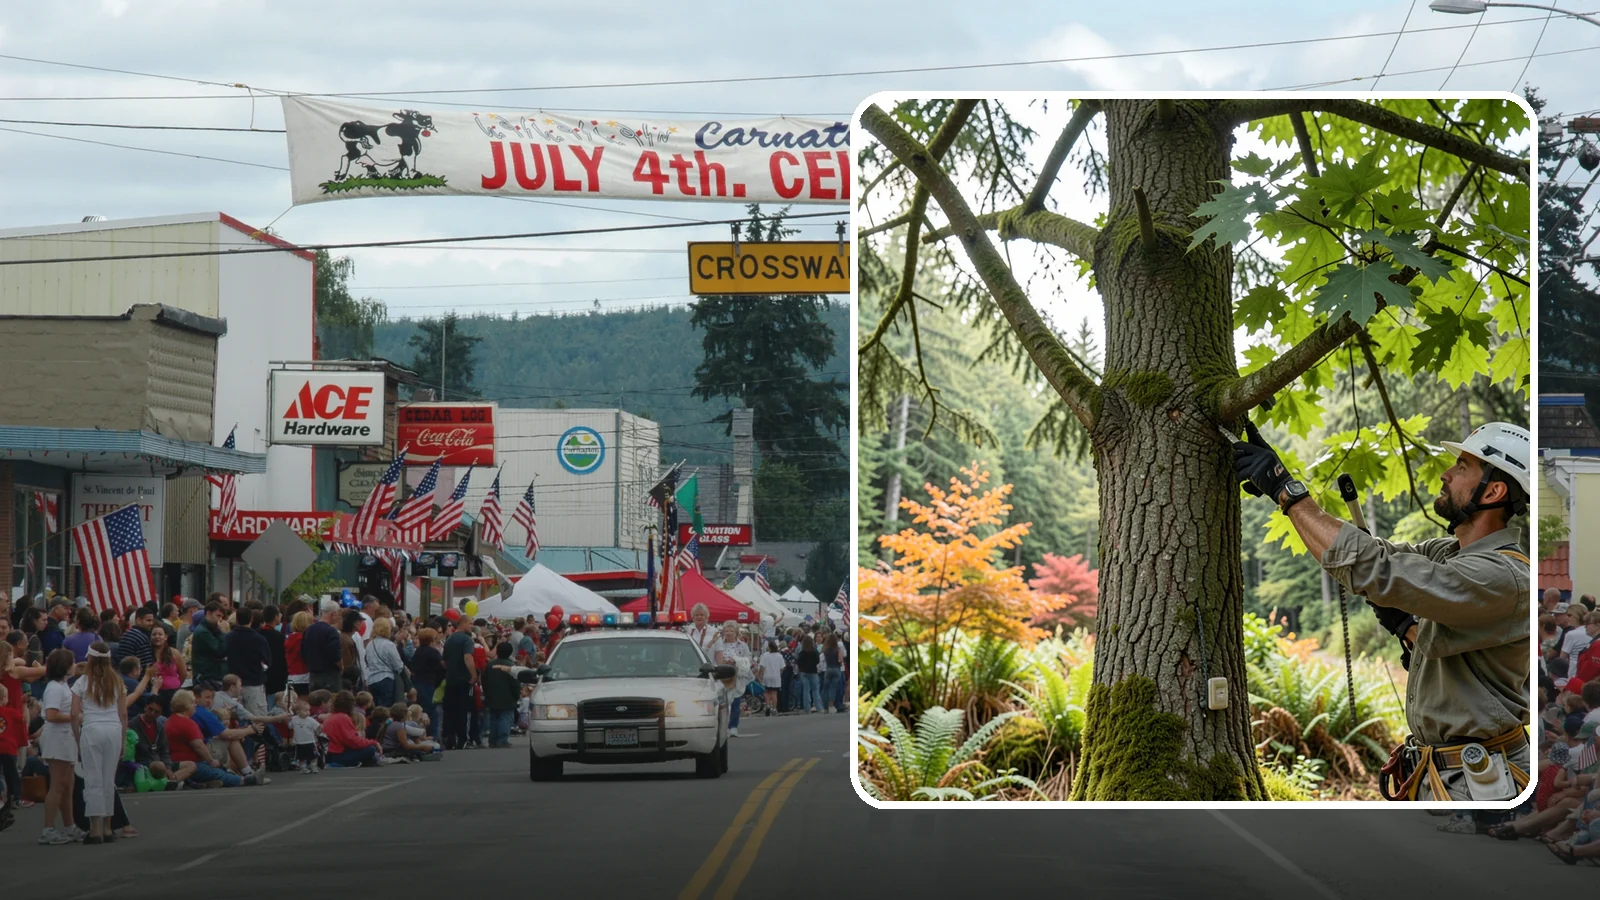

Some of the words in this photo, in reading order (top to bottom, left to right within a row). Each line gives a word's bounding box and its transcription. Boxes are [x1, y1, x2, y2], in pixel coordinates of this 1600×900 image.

[694, 121, 850, 150] Carnat
[481, 141, 605, 193] JULY
[632, 150, 747, 198] 4th.
[697, 254, 850, 280] CROSSWA
[282, 380, 374, 420] ACE
[405, 409, 453, 422] CEDAR
[461, 408, 485, 421] LOG
[283, 421, 371, 436] Hardware
[416, 428, 477, 447] Coca-Cola
[353, 466, 386, 480] Simpl
[83, 485, 94, 494] St.
[95, 485, 124, 494] Vincent
[126, 485, 136, 494] de
[137, 486, 155, 495] Paul
[80, 502, 154, 522] THT
[688, 526, 741, 535] CRNATION
[699, 535, 730, 543] GLASS
